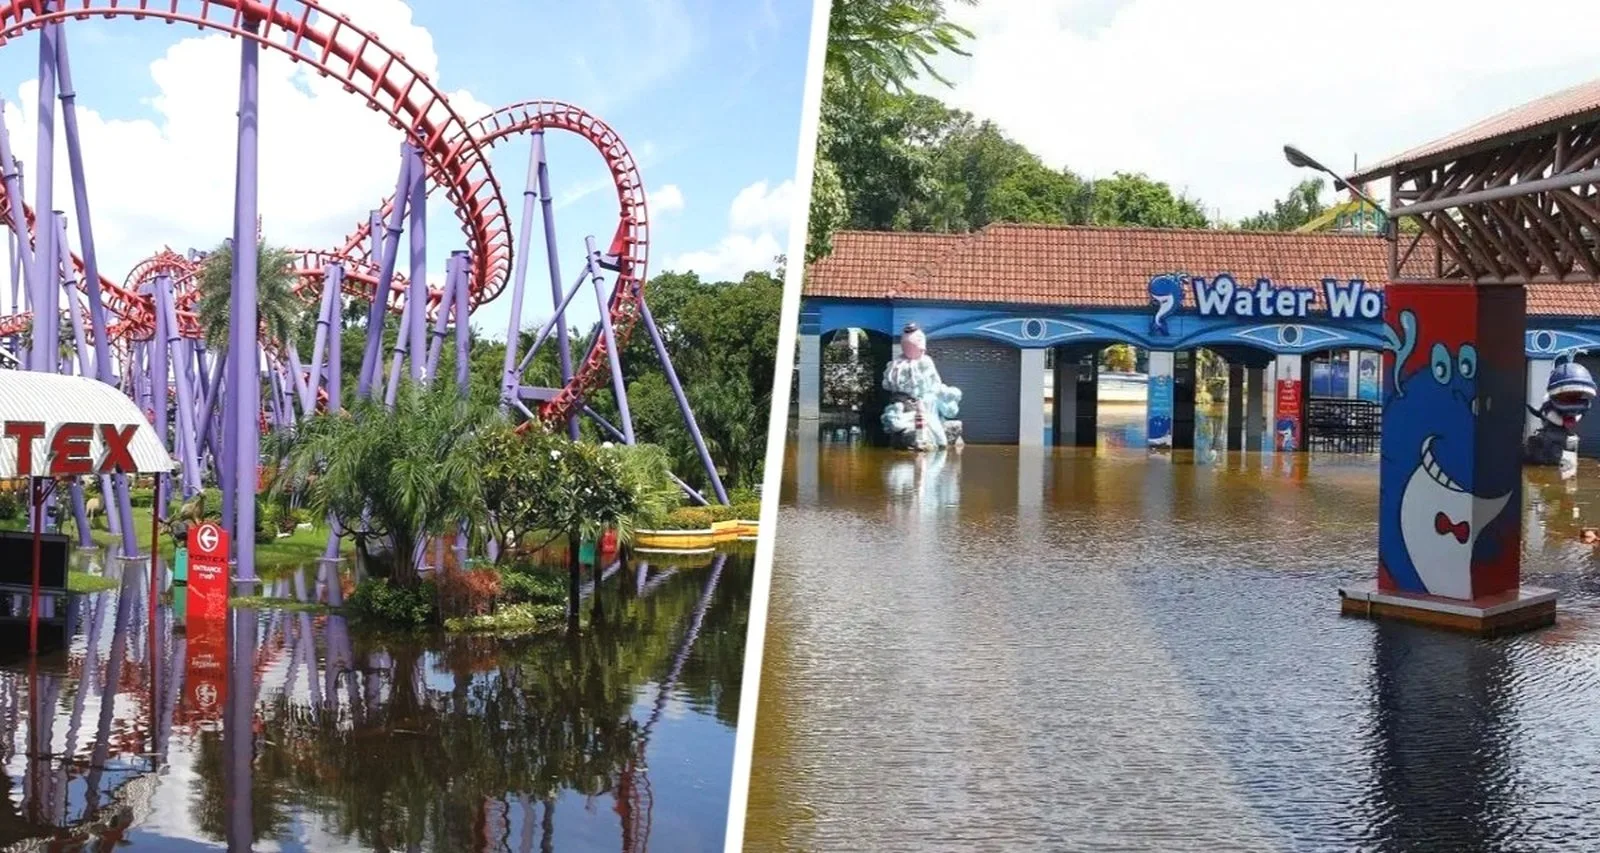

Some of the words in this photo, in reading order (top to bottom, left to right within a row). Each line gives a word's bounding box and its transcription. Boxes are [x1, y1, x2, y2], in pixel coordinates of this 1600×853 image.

[1193, 276, 1315, 317] Water
[4, 420, 140, 475] TEX
[192, 564, 222, 573] ENTRANCE
